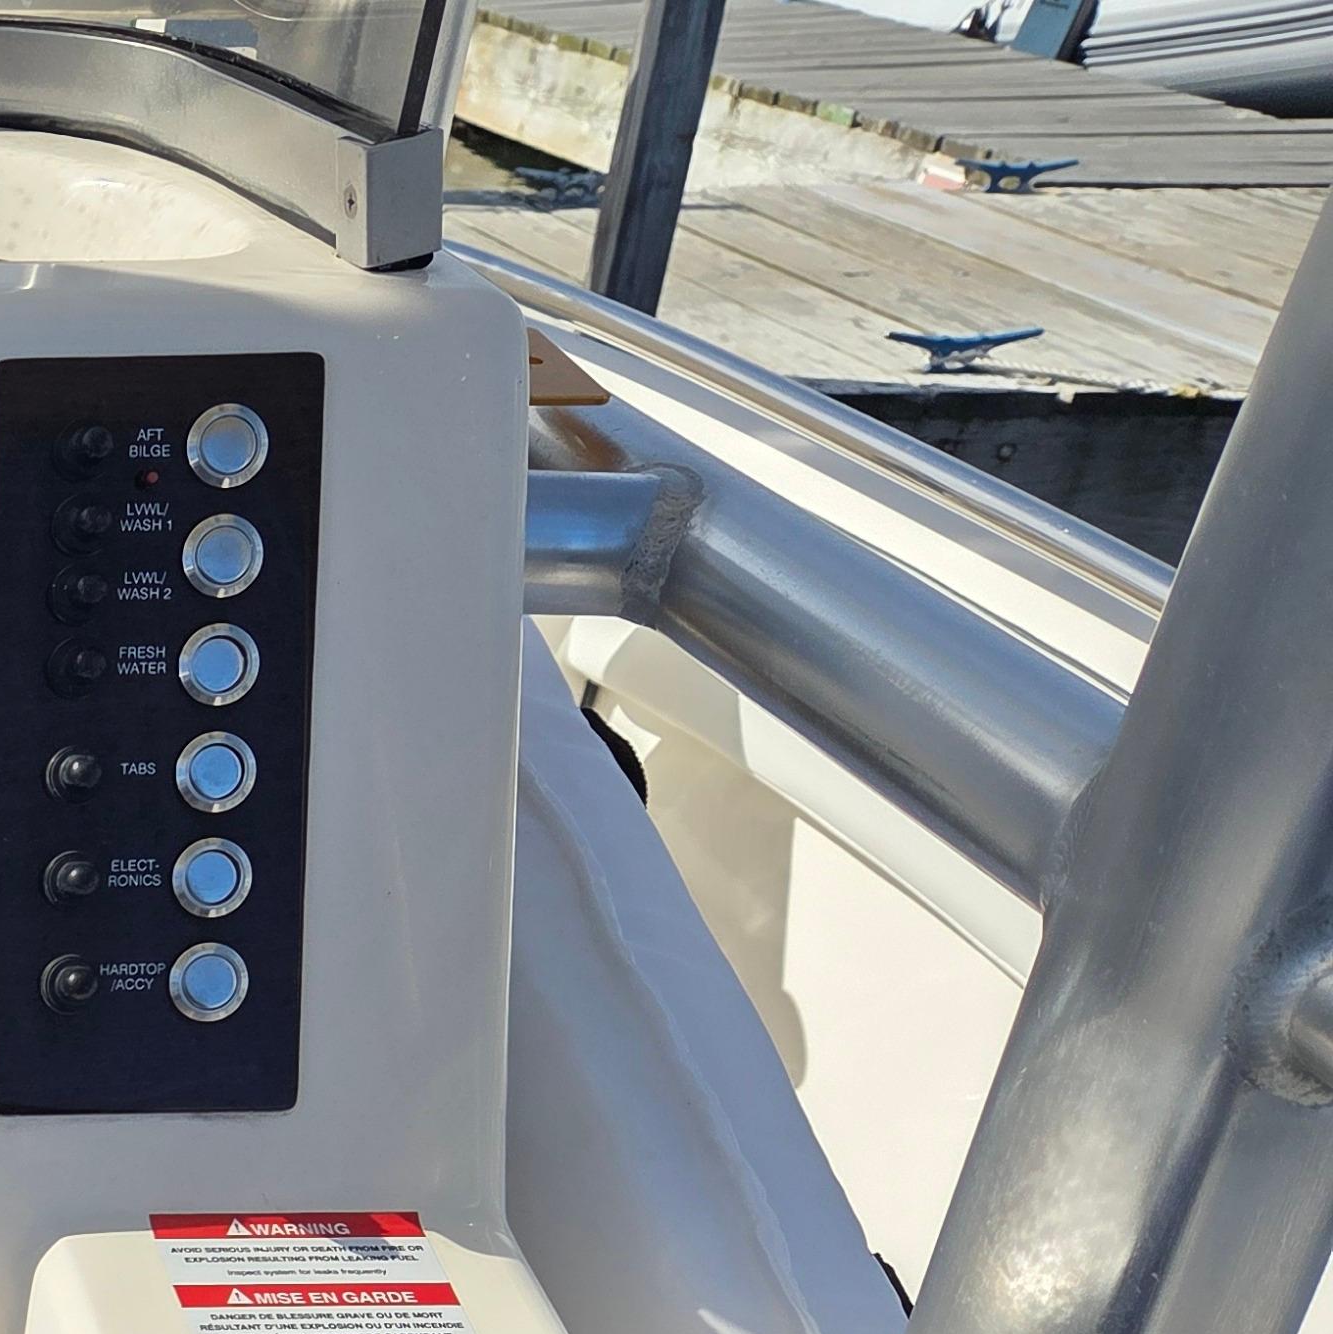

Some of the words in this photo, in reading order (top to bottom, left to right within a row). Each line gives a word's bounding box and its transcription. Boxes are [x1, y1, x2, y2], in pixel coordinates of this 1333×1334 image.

[137, 428, 164, 441] AFT
[128, 445, 171, 458] BILGE
[127, 503, 169, 516] LVWL/
[120, 519, 165, 531] WASH
[168, 519, 173, 531] 1
[124, 572, 167, 585] LVWL/
[117, 588, 162, 600] WASH
[164, 588, 172, 600] 2
[119, 646, 166, 658] FRESH
[117, 662, 167, 675] WATER
[120, 763, 157, 775] TABS
[111, 860, 160, 872] ELECT-
[108, 874, 162, 887] RONICS
[100, 963, 166, 976] HARDTOP
[110, 978, 154, 992] /ACCY
[250, 1222, 351, 1236] WARNING
[247, 1255, 307, 1263] RESULTING
[308, 1255, 340, 1263] FROM
[341, 1254, 389, 1262] LEAKING
[253, 1292, 306, 1304] MISE
[308, 1292, 339, 1304] EN
[342, 1291, 418, 1304] GARDE
